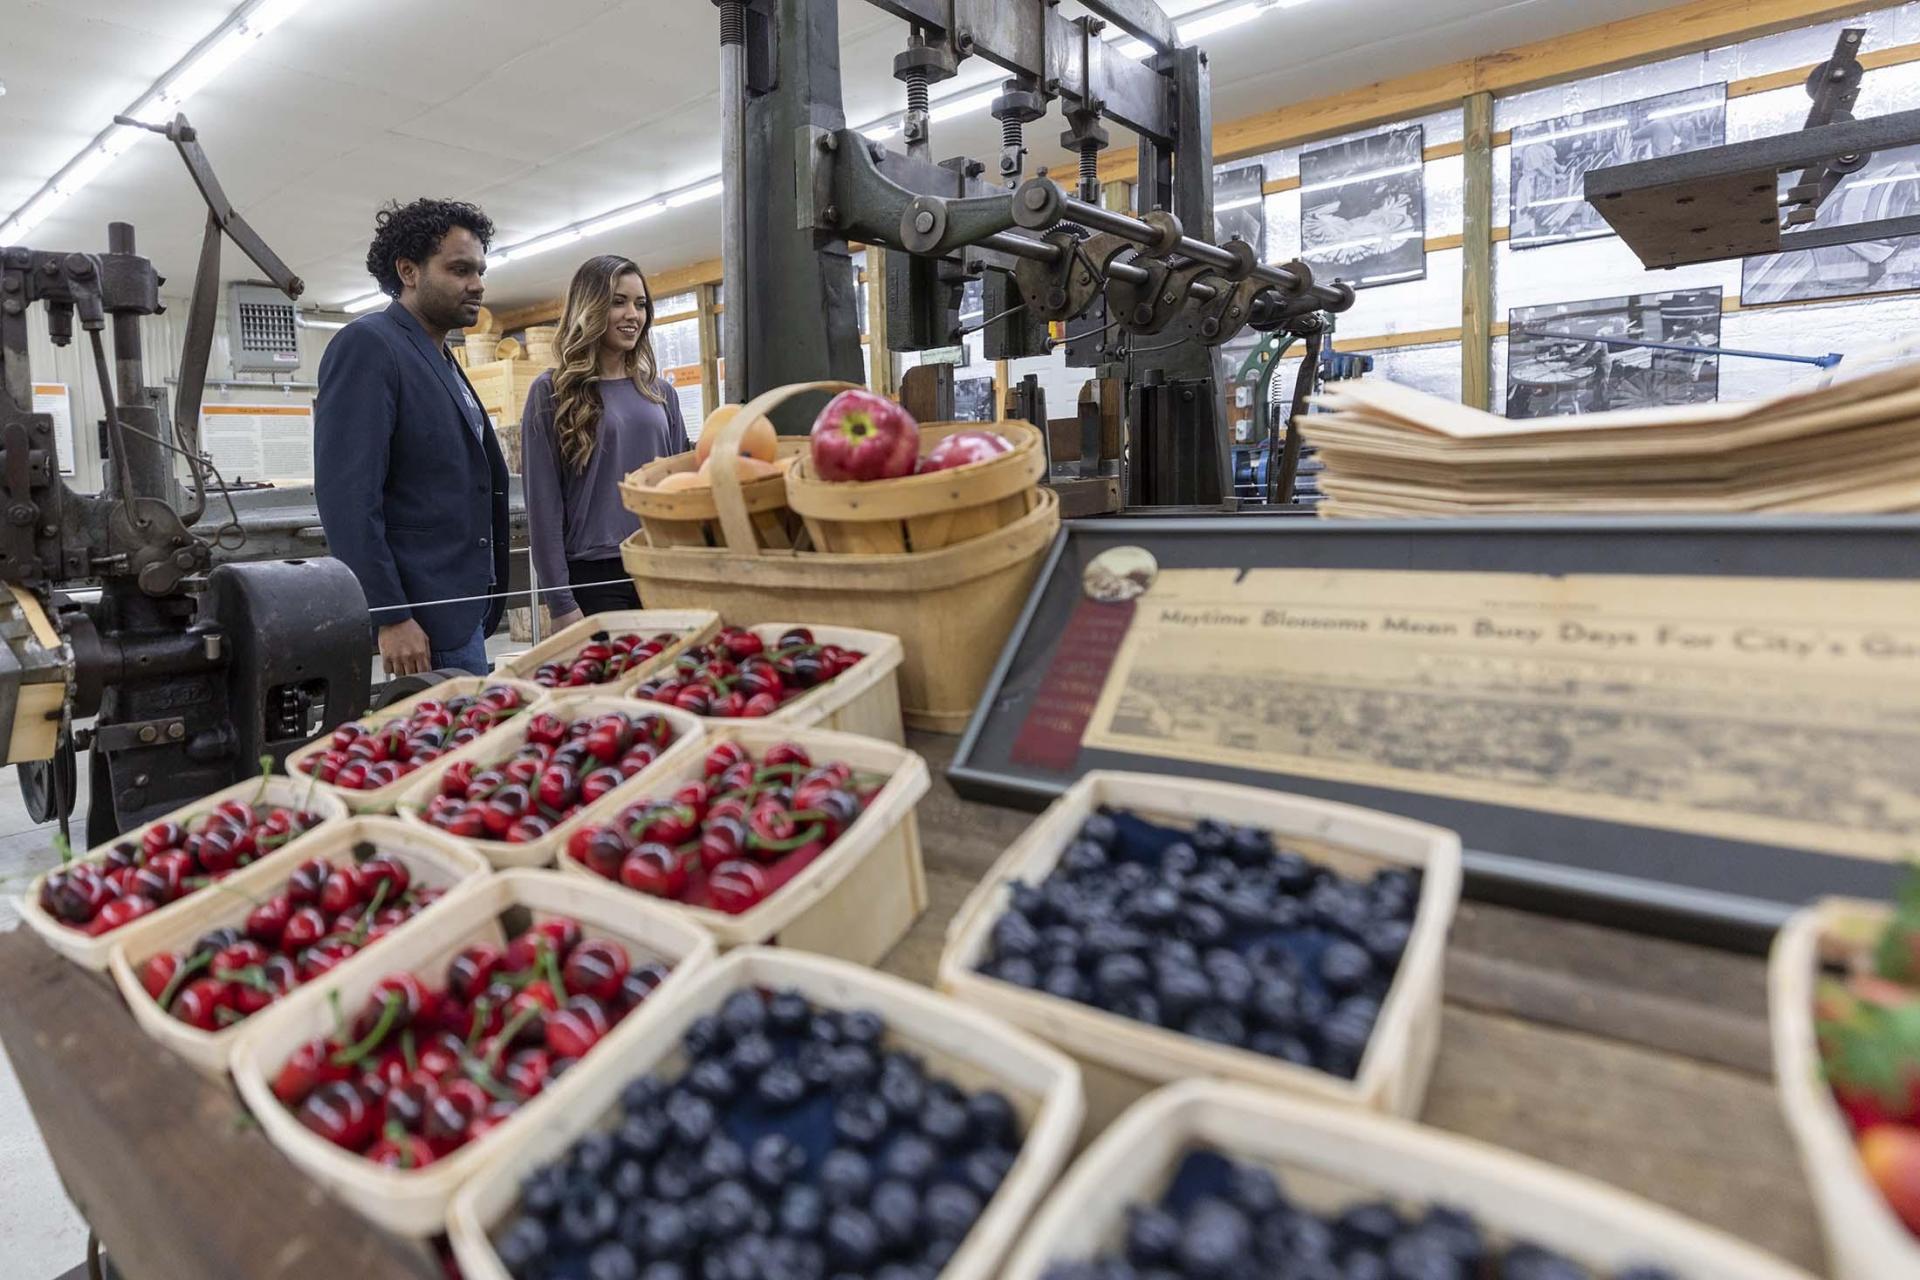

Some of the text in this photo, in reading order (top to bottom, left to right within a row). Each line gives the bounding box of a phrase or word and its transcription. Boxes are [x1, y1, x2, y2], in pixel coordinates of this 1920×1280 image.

[1160, 608, 1249, 628] Maytime
[1261, 607, 1369, 631] Blossoms
[1382, 616, 1459, 634] Mean
[1473, 617, 1543, 645] Busy
[1559, 621, 1639, 651] Days
[1654, 623, 1714, 650] For
